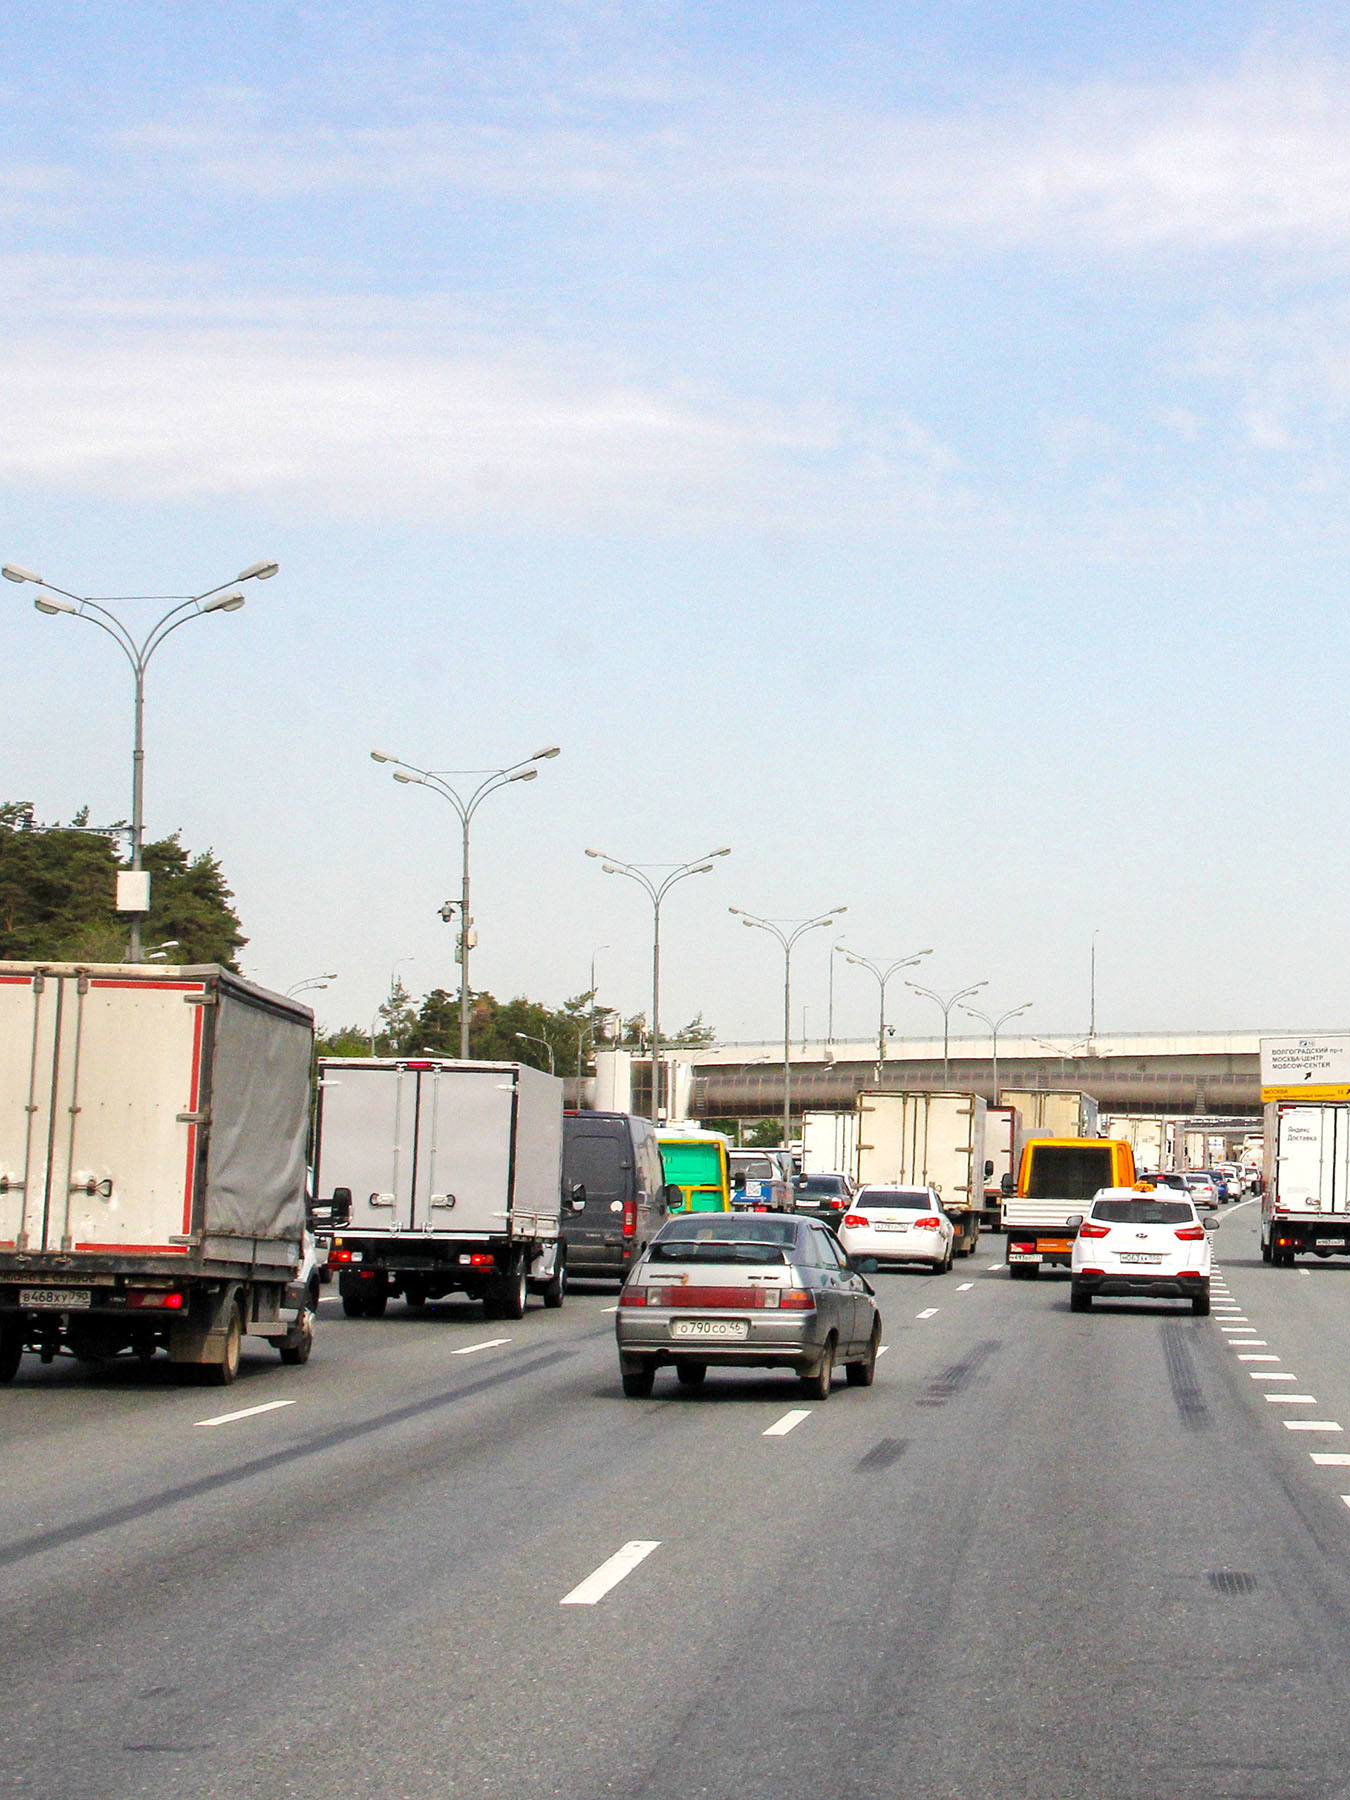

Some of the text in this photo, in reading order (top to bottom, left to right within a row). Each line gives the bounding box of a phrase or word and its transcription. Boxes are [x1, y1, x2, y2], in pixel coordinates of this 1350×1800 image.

[1271, 1047, 1328, 1056] ВОЛГОГРАДСКИЙ
[1272, 1055, 1324, 1063] МОСКВА-ЦЕНТР
[1272, 1062, 1331, 1070] MOSCOW-CENTER
[1287, 1126, 1311, 1134] Яндекс
[1287, 1134, 1317, 1142] Доставка
